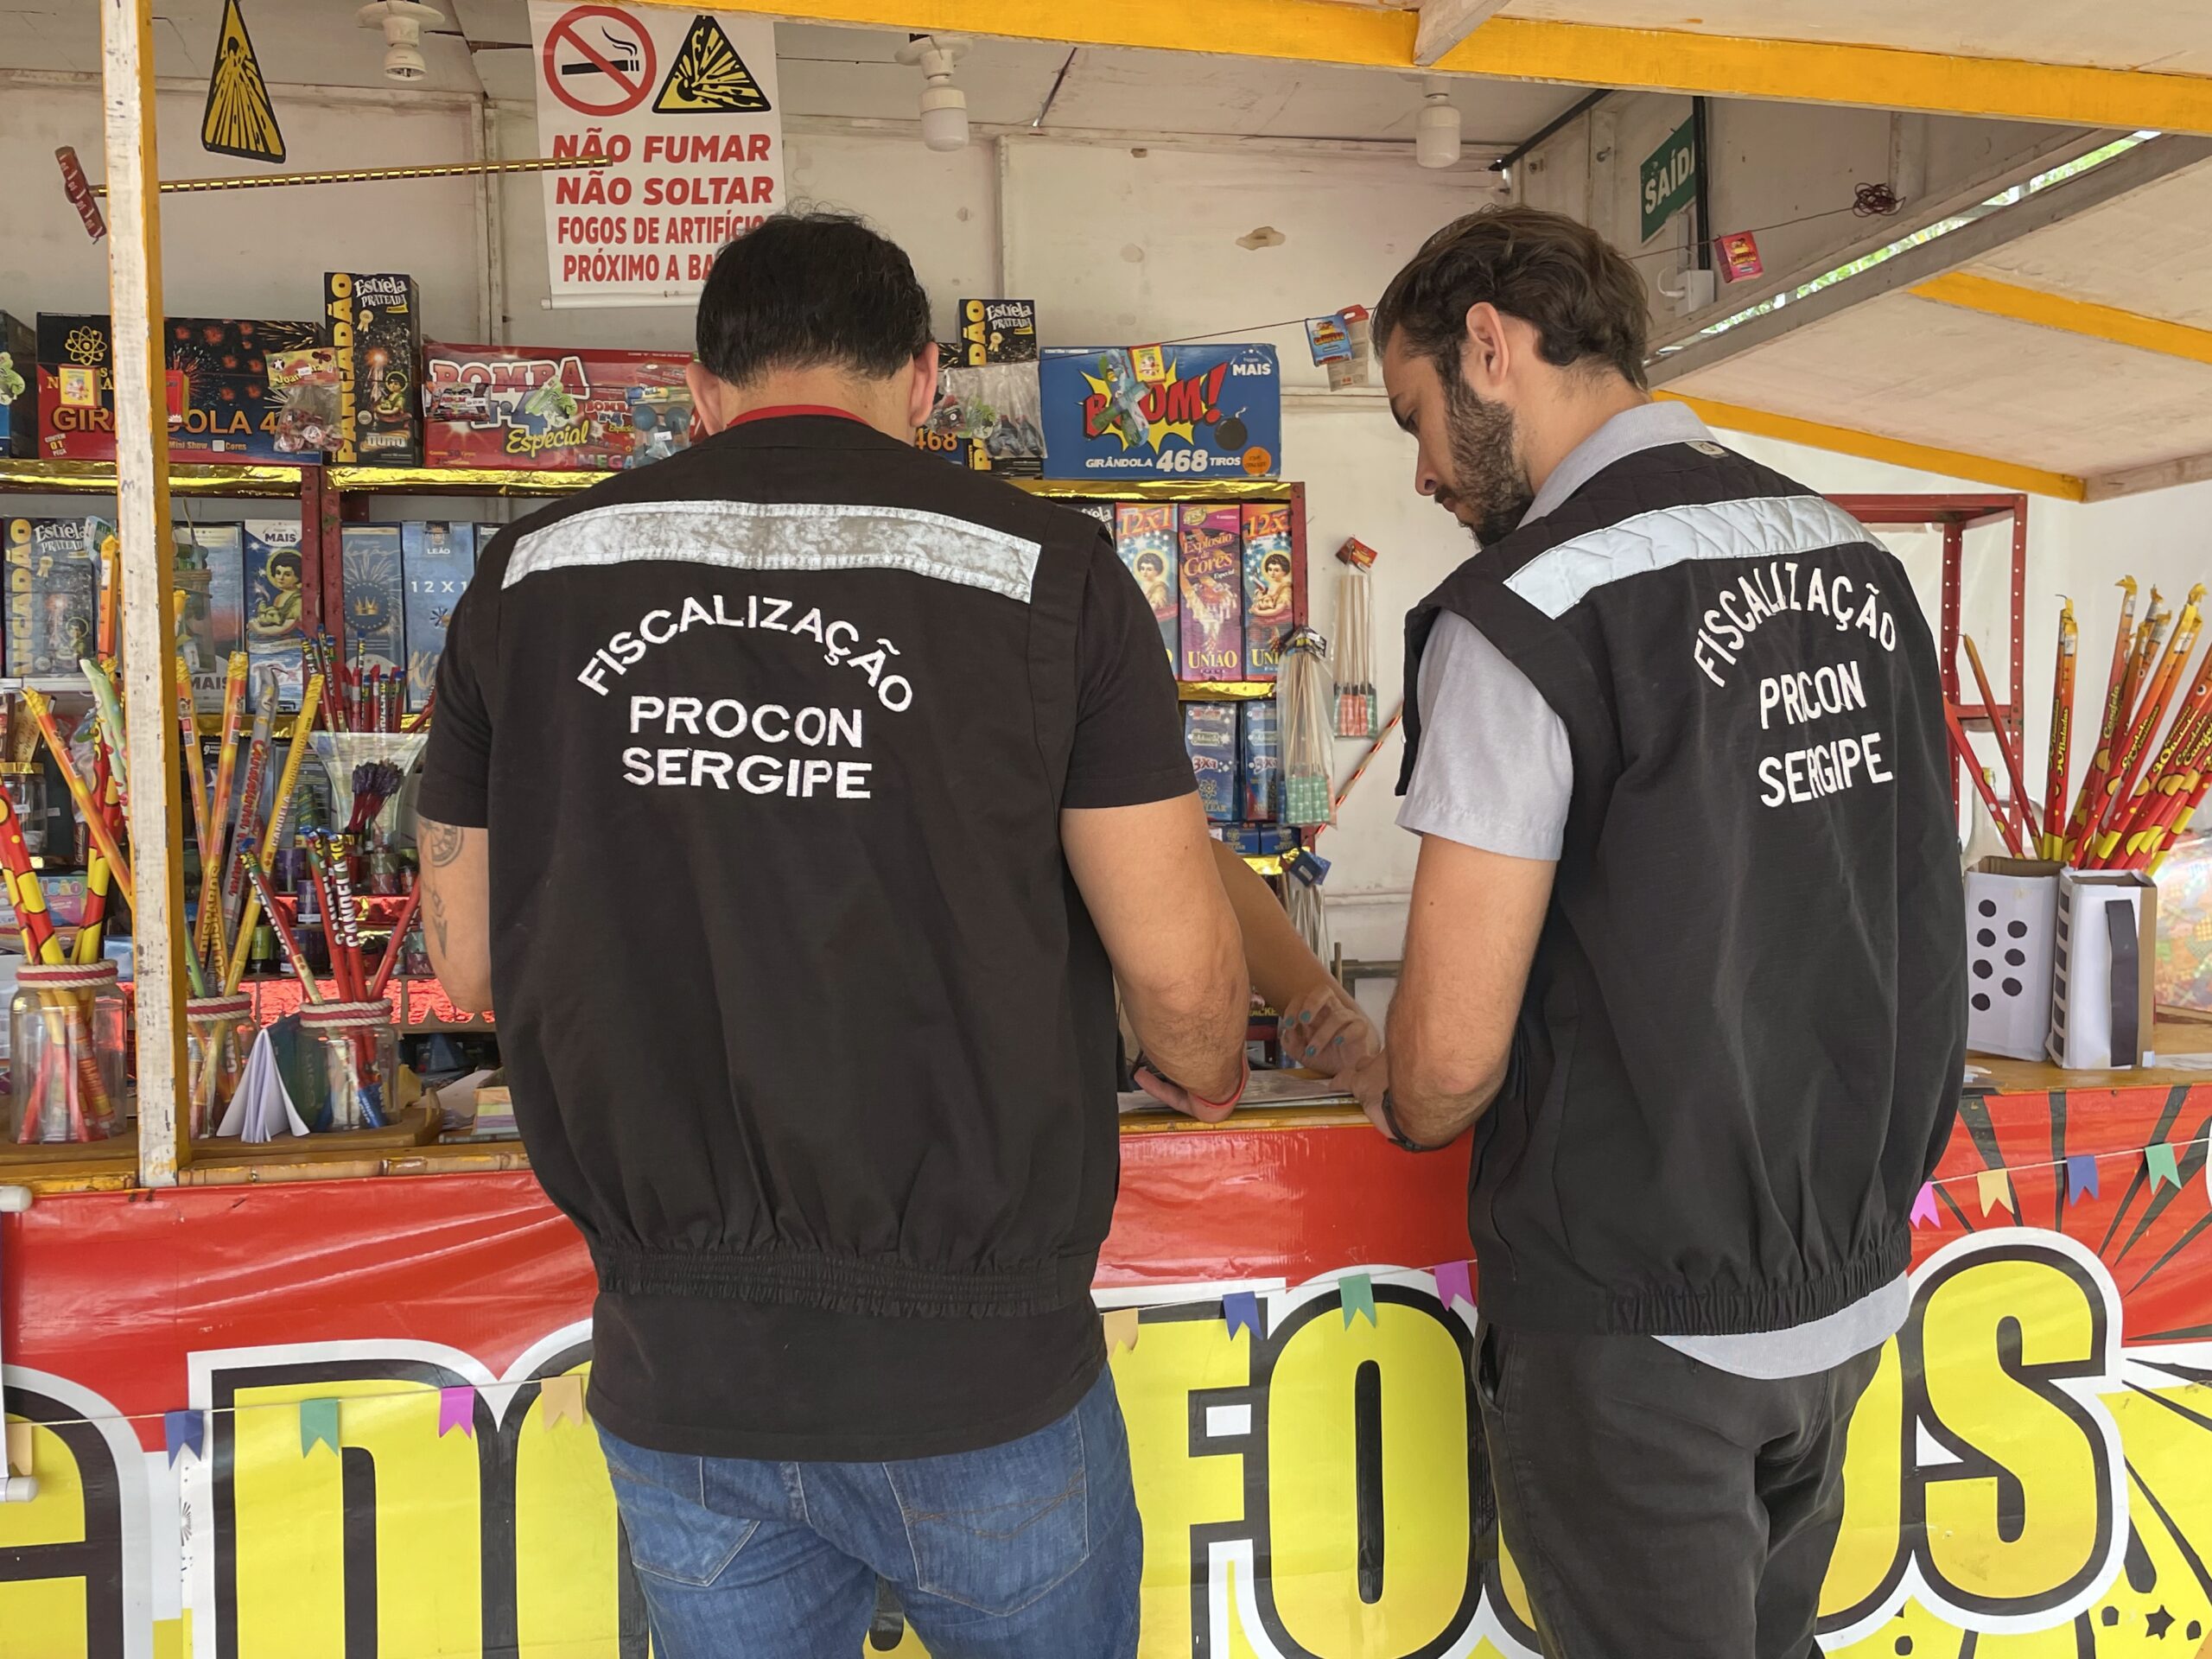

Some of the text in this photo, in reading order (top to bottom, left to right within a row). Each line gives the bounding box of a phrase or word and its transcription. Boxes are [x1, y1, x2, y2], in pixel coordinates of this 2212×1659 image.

[552, 127, 772, 162] NÃO FUMAR
[556, 170, 774, 205] NÃO SOLTAR
[557, 216, 626, 244] FOGOS
[633, 218, 659, 244] DE
[563, 248, 659, 283] PRÓXIMO
[665, 254, 680, 281] A
[353, 276, 409, 298] Estrela
[985, 302, 1033, 321] Estrela
[1232, 363, 1271, 376] MAIS
[1083, 361, 1229, 438] BOM!
[505, 421, 589, 459] Especial
[577, 454, 634, 467] MEGA
[1085, 456, 1154, 468] GIRÂNDOLA
[1155, 449, 1210, 473] 468
[1210, 456, 1242, 467] TIROS
[33, 522, 89, 543] Estrela
[264, 533, 297, 543] MAIS
[1184, 532, 1233, 555] Explosão
[41, 539, 84, 554] PRATEAD
[1184, 554, 1234, 576] Cores
[1694, 562, 1897, 688] FISCALIZAÇÃO
[577, 594, 912, 712] FISCALIZAÇÃO
[1188, 650, 1238, 670] UNIÃO
[1251, 649, 1280, 667] UNI
[630, 695, 862, 748] PROCON
[621, 747, 872, 799] SERGIPE
[1758, 732, 1893, 808] SERGIPE
[334, 860, 360, 948] CANDELA
